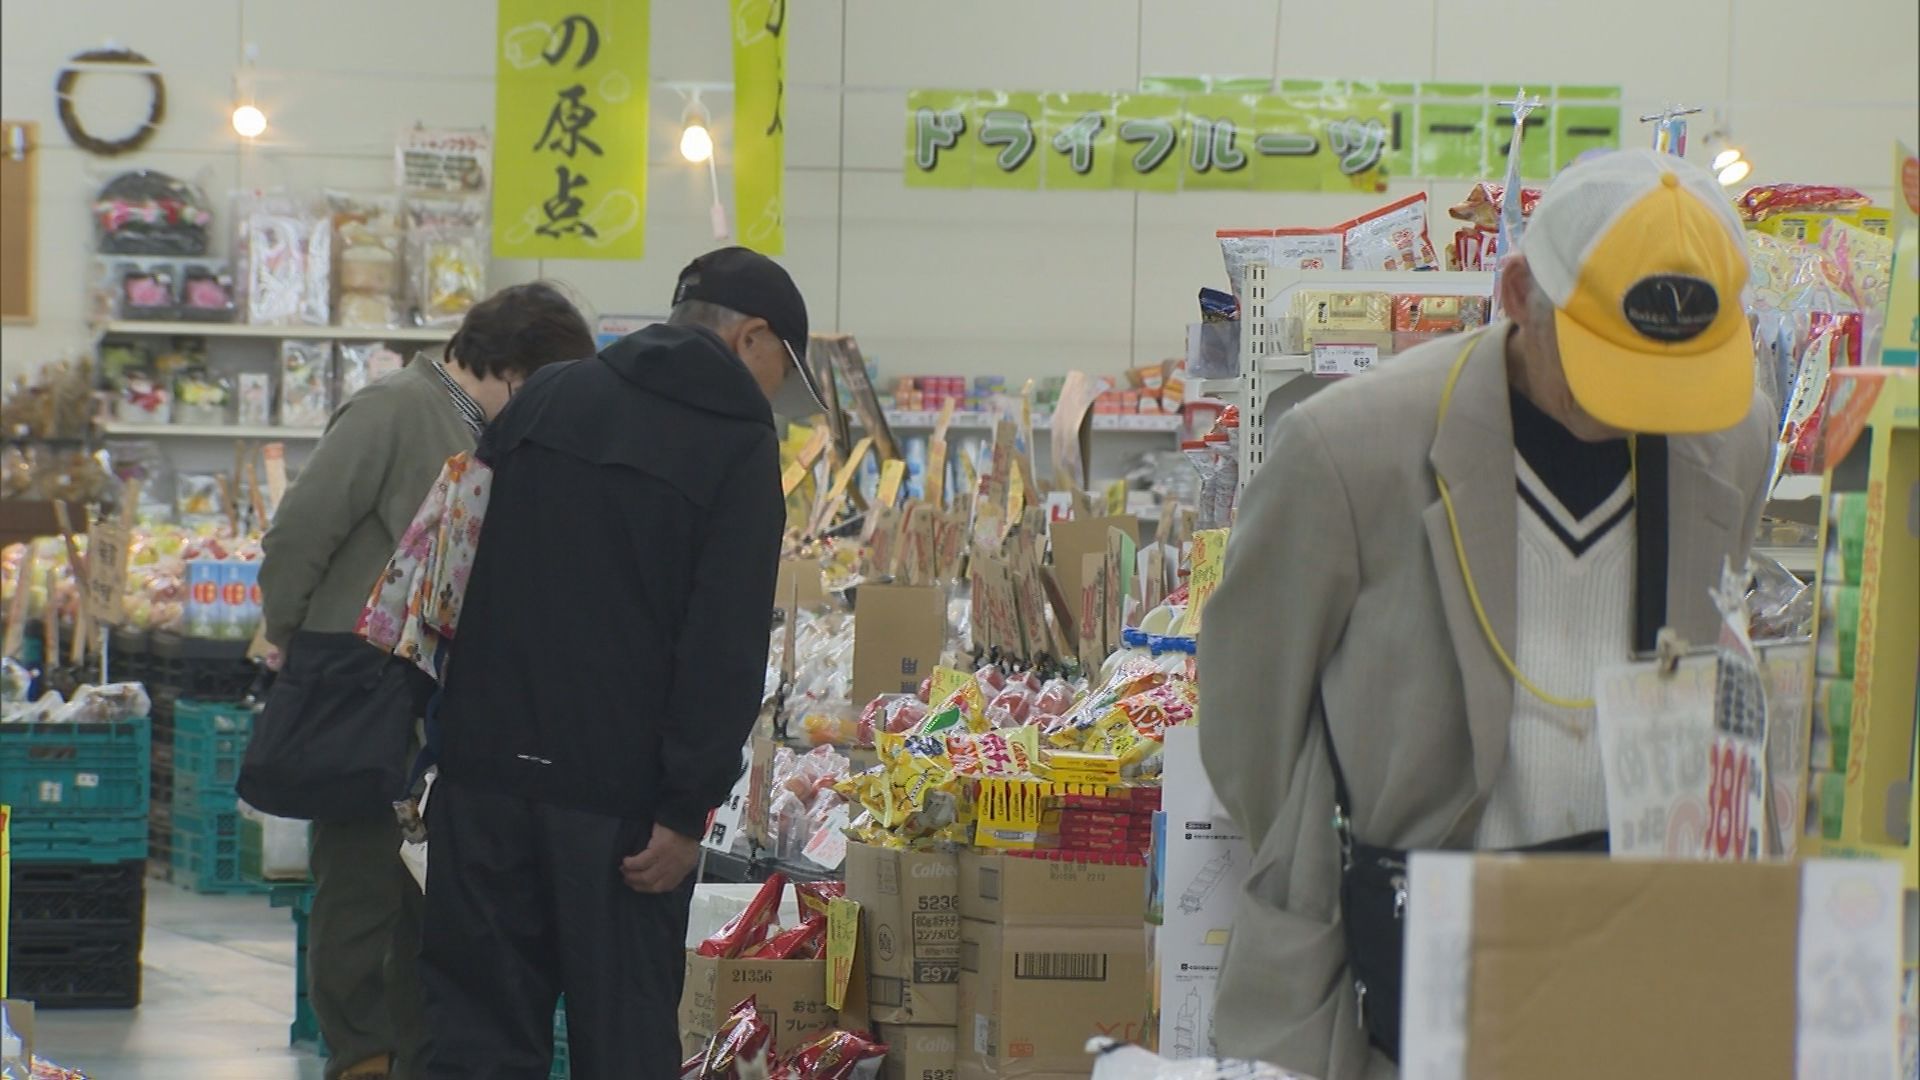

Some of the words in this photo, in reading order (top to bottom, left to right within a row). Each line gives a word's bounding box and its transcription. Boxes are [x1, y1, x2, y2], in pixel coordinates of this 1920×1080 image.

[533, 13, 605, 240] の原点
[915, 107, 1387, 174] ドライフルーツ
[732, 969, 772, 983] 21356
